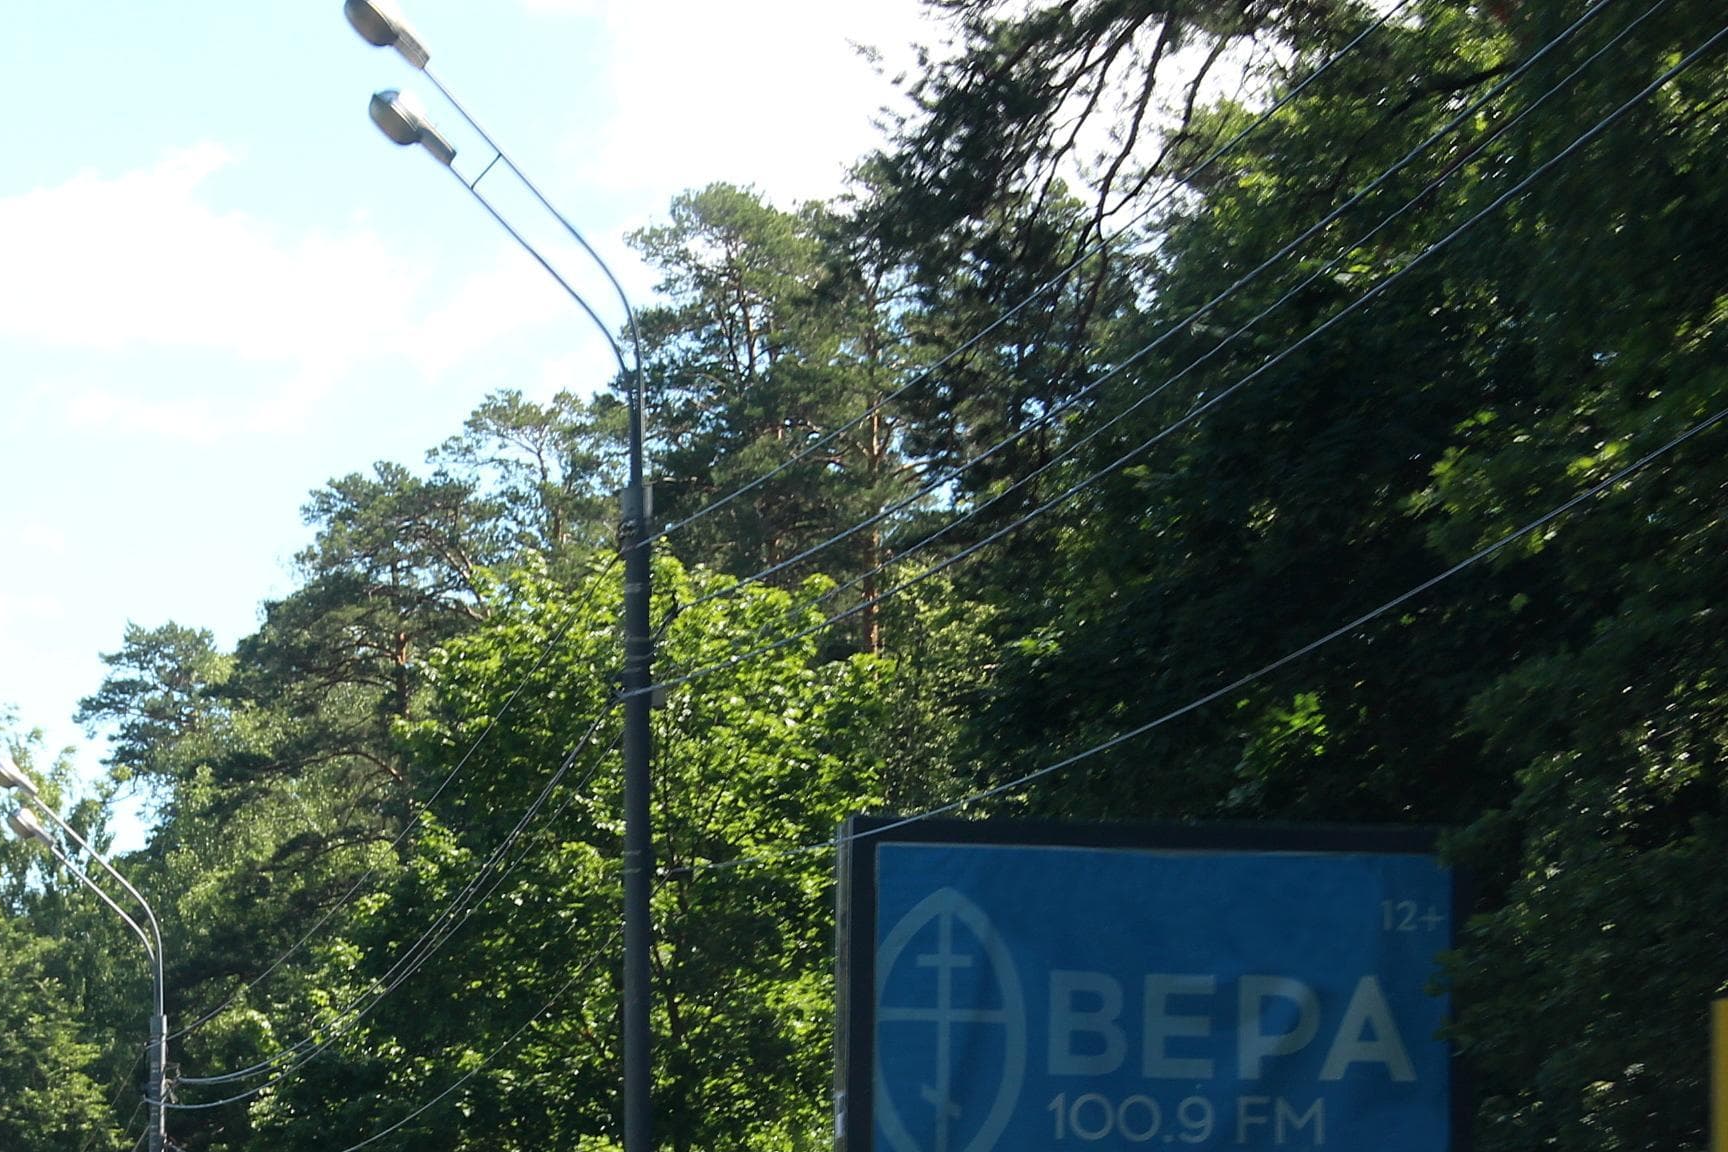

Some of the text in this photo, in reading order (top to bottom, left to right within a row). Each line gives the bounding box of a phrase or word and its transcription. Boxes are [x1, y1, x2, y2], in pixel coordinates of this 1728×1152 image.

[1381, 898, 1446, 933] 12+
[1047, 969, 1418, 1083] ВЕРА
[1048, 1092, 1326, 1146] 100.9 FM
